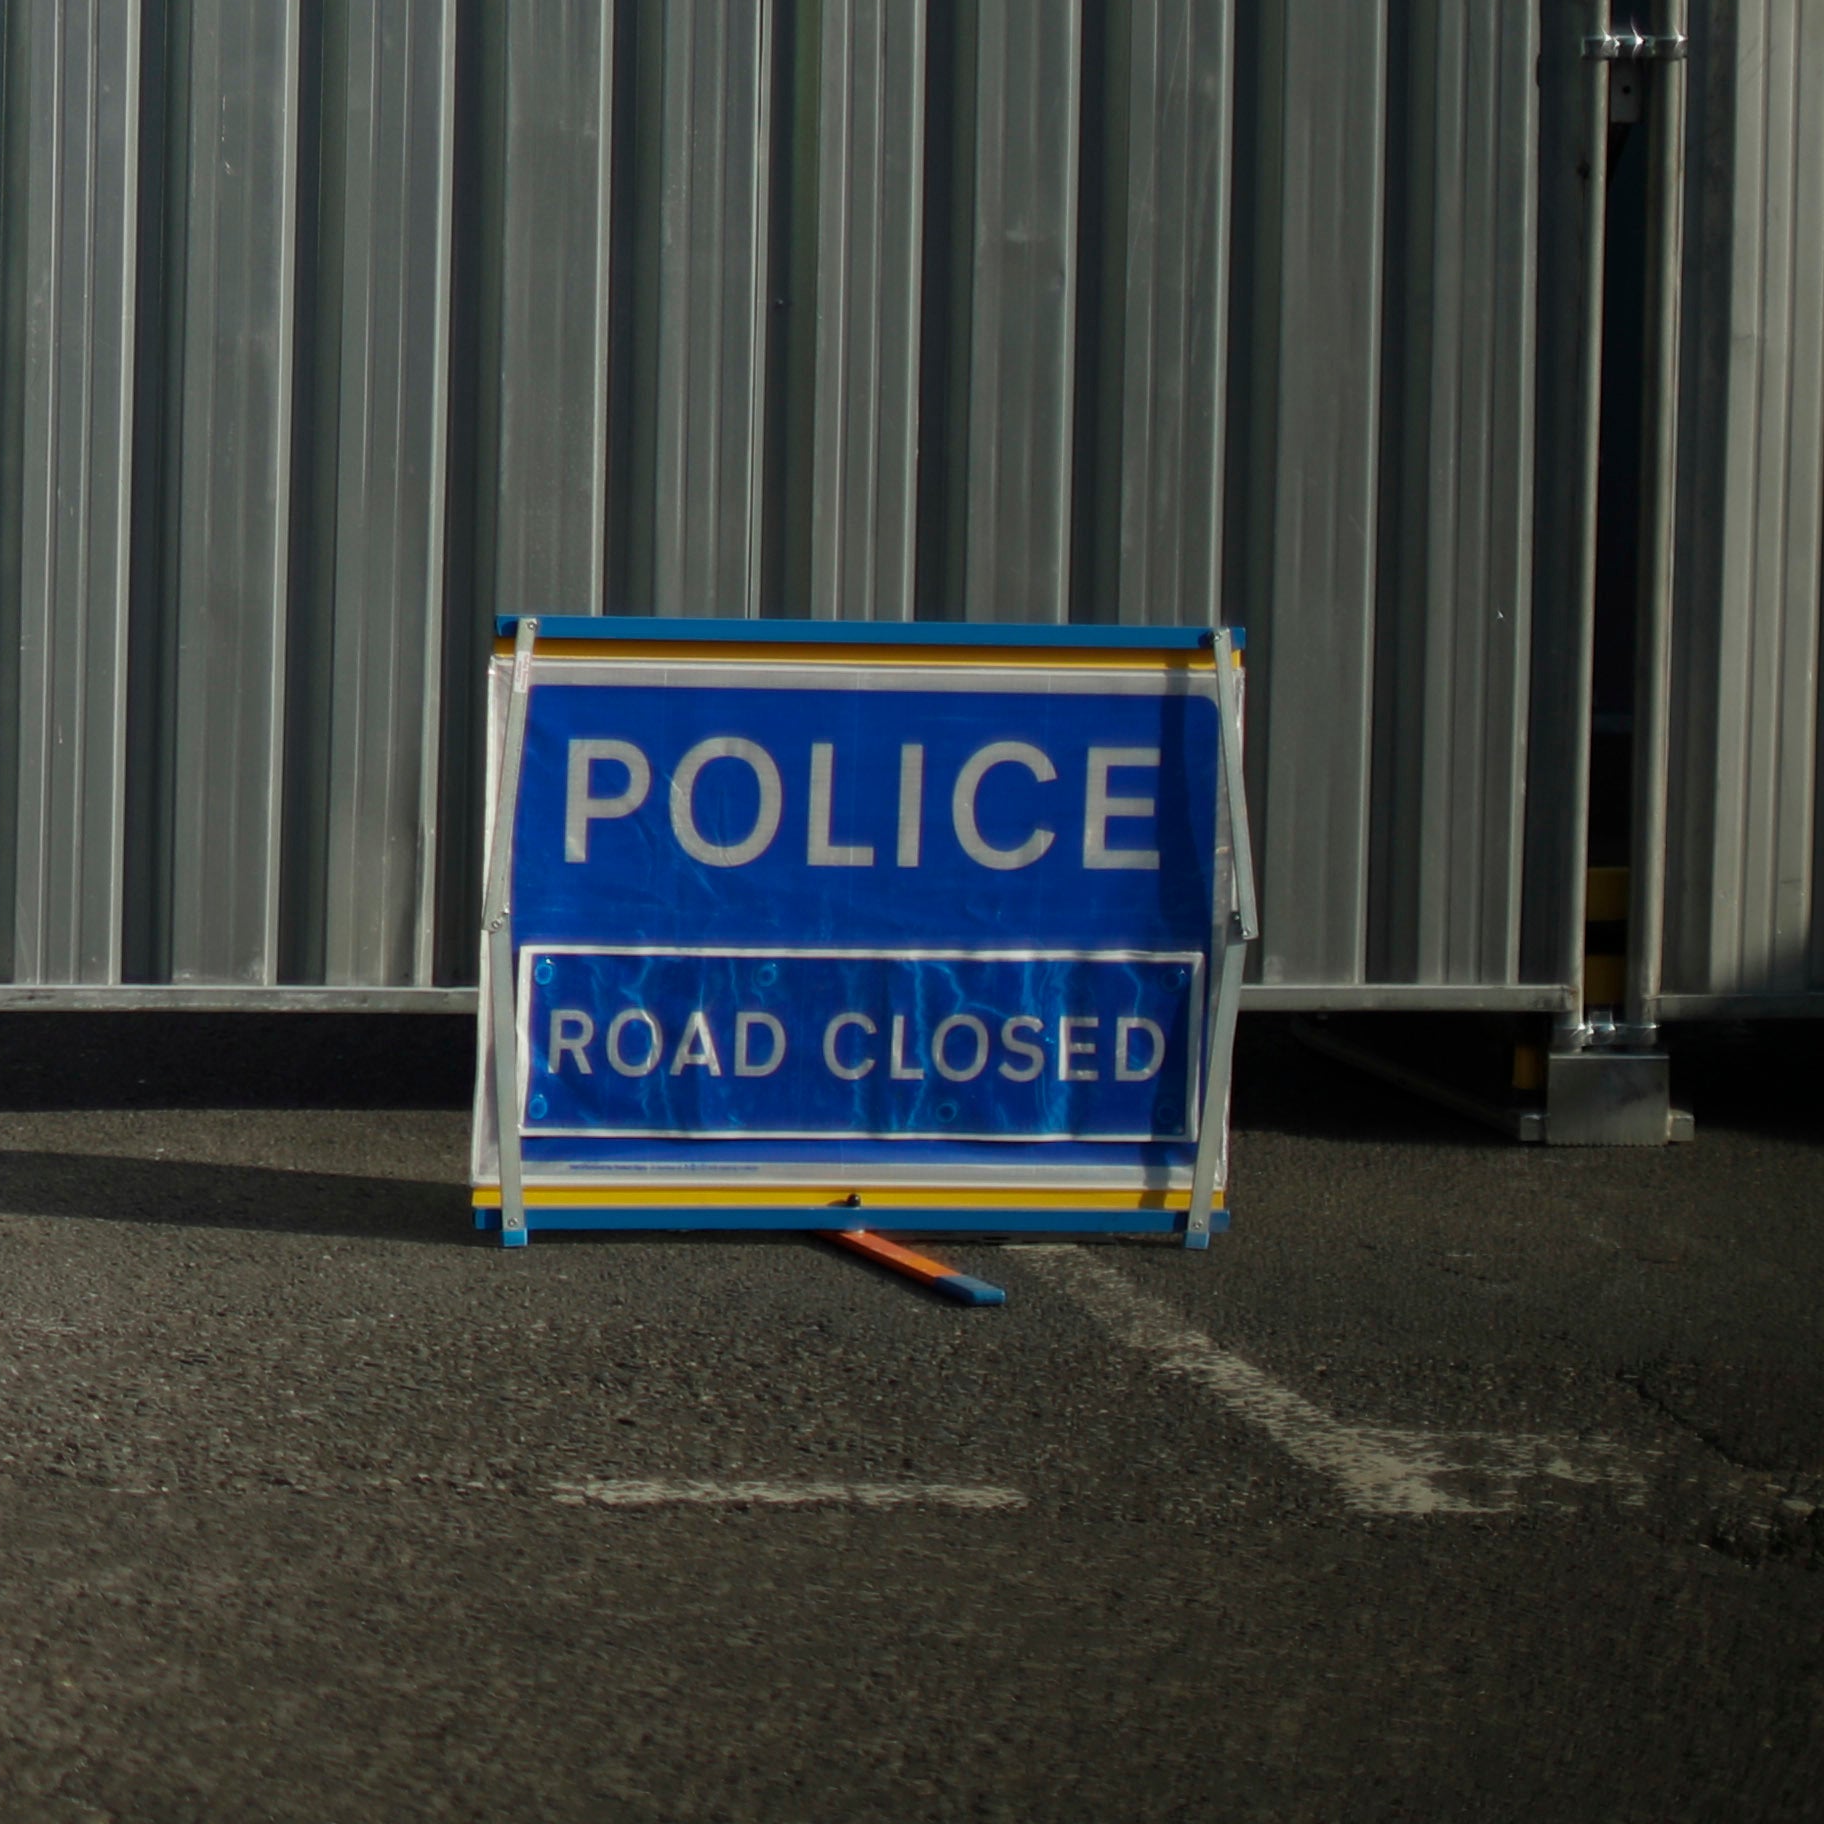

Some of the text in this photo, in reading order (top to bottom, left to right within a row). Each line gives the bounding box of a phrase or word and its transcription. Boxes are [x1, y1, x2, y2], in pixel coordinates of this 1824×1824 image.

[564, 736, 1161, 871] POLICE
[547, 1007, 1167, 1084] ROAD CLOSED
